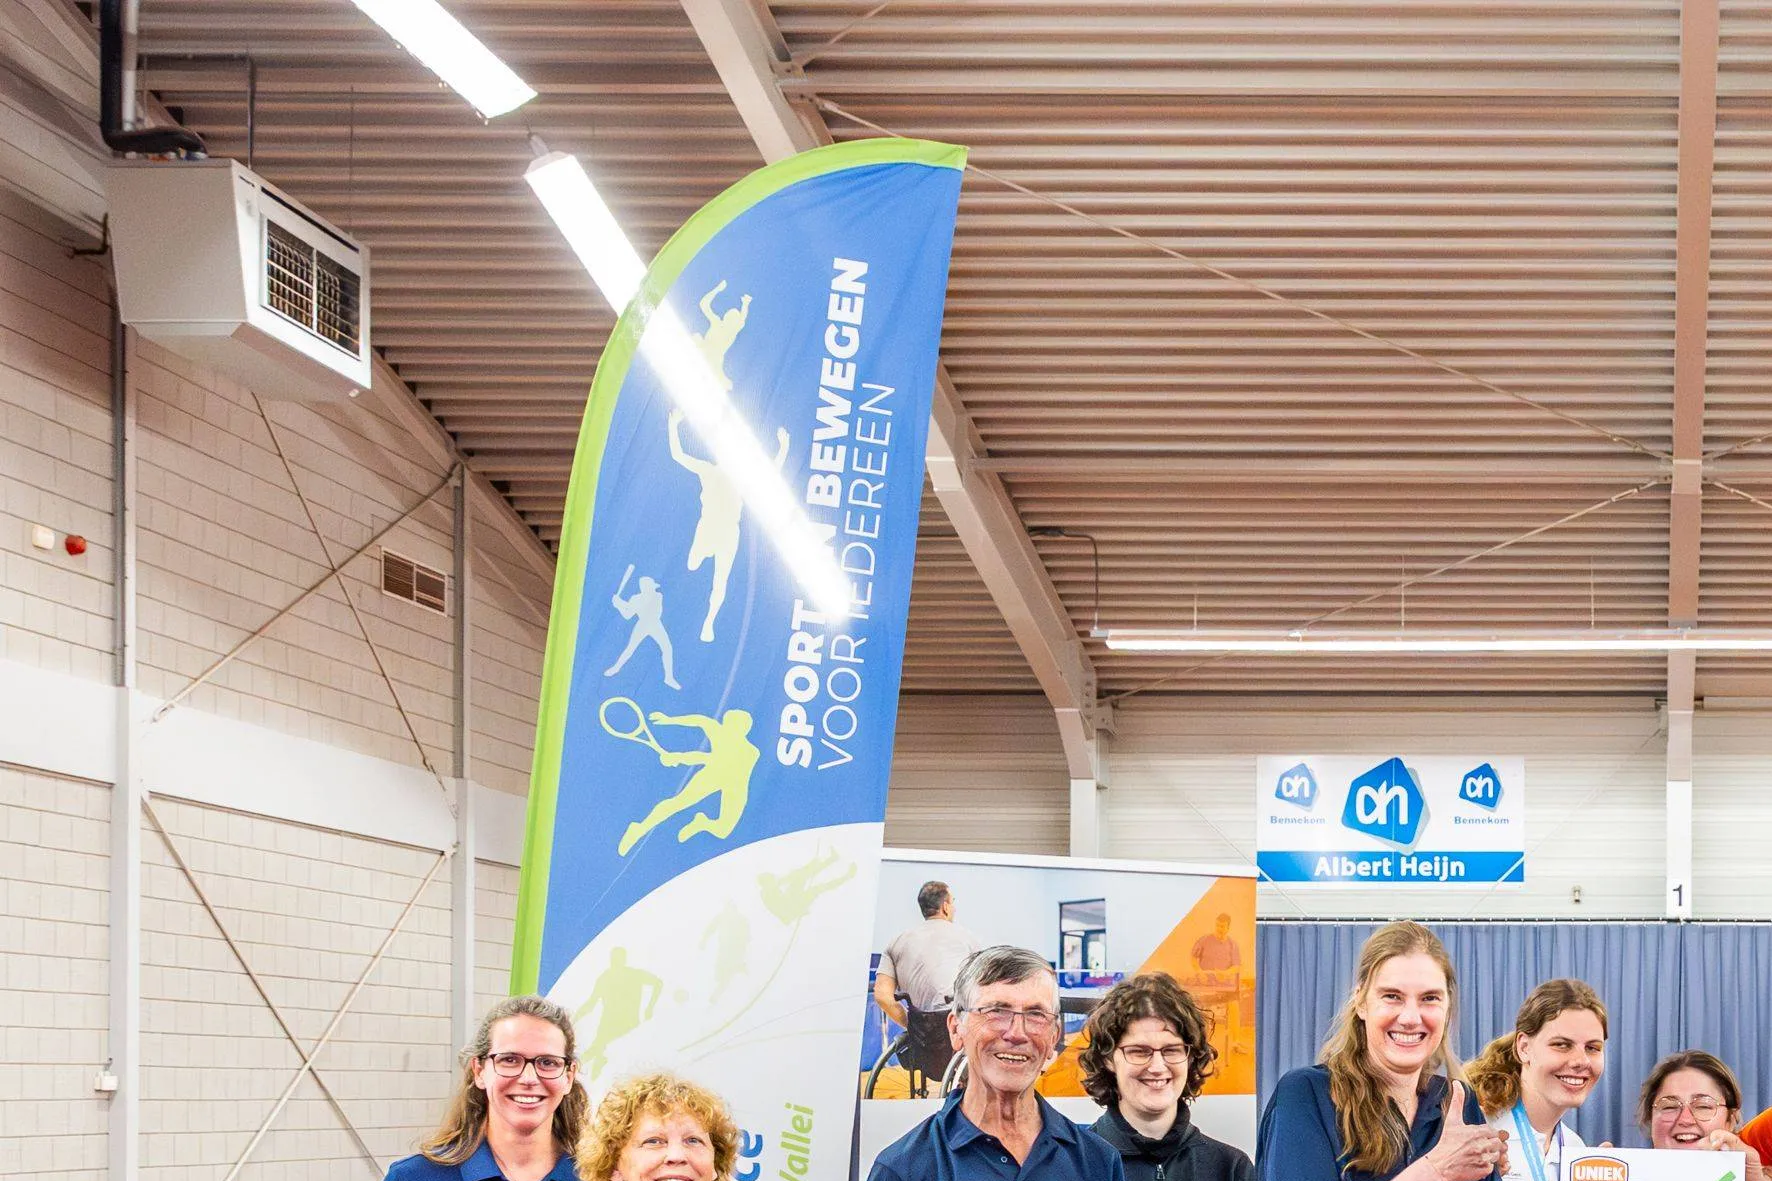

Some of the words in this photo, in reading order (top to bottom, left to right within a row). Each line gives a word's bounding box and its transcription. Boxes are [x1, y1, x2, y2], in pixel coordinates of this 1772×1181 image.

[777, 598, 826, 769] SPORT
[806, 257, 869, 508] BEWEGEN
[838, 383, 896, 620] IEDEREEN
[817, 634, 867, 770] VOOR
[1270, 815, 1326, 825] Bennekom
[1454, 815, 1510, 825] Bennekom
[1314, 857, 1392, 877] Albert
[1400, 857, 1465, 881] Heijn
[1672, 884, 1684, 907] 1
[1575, 1165, 1624, 1180] UNIEK
